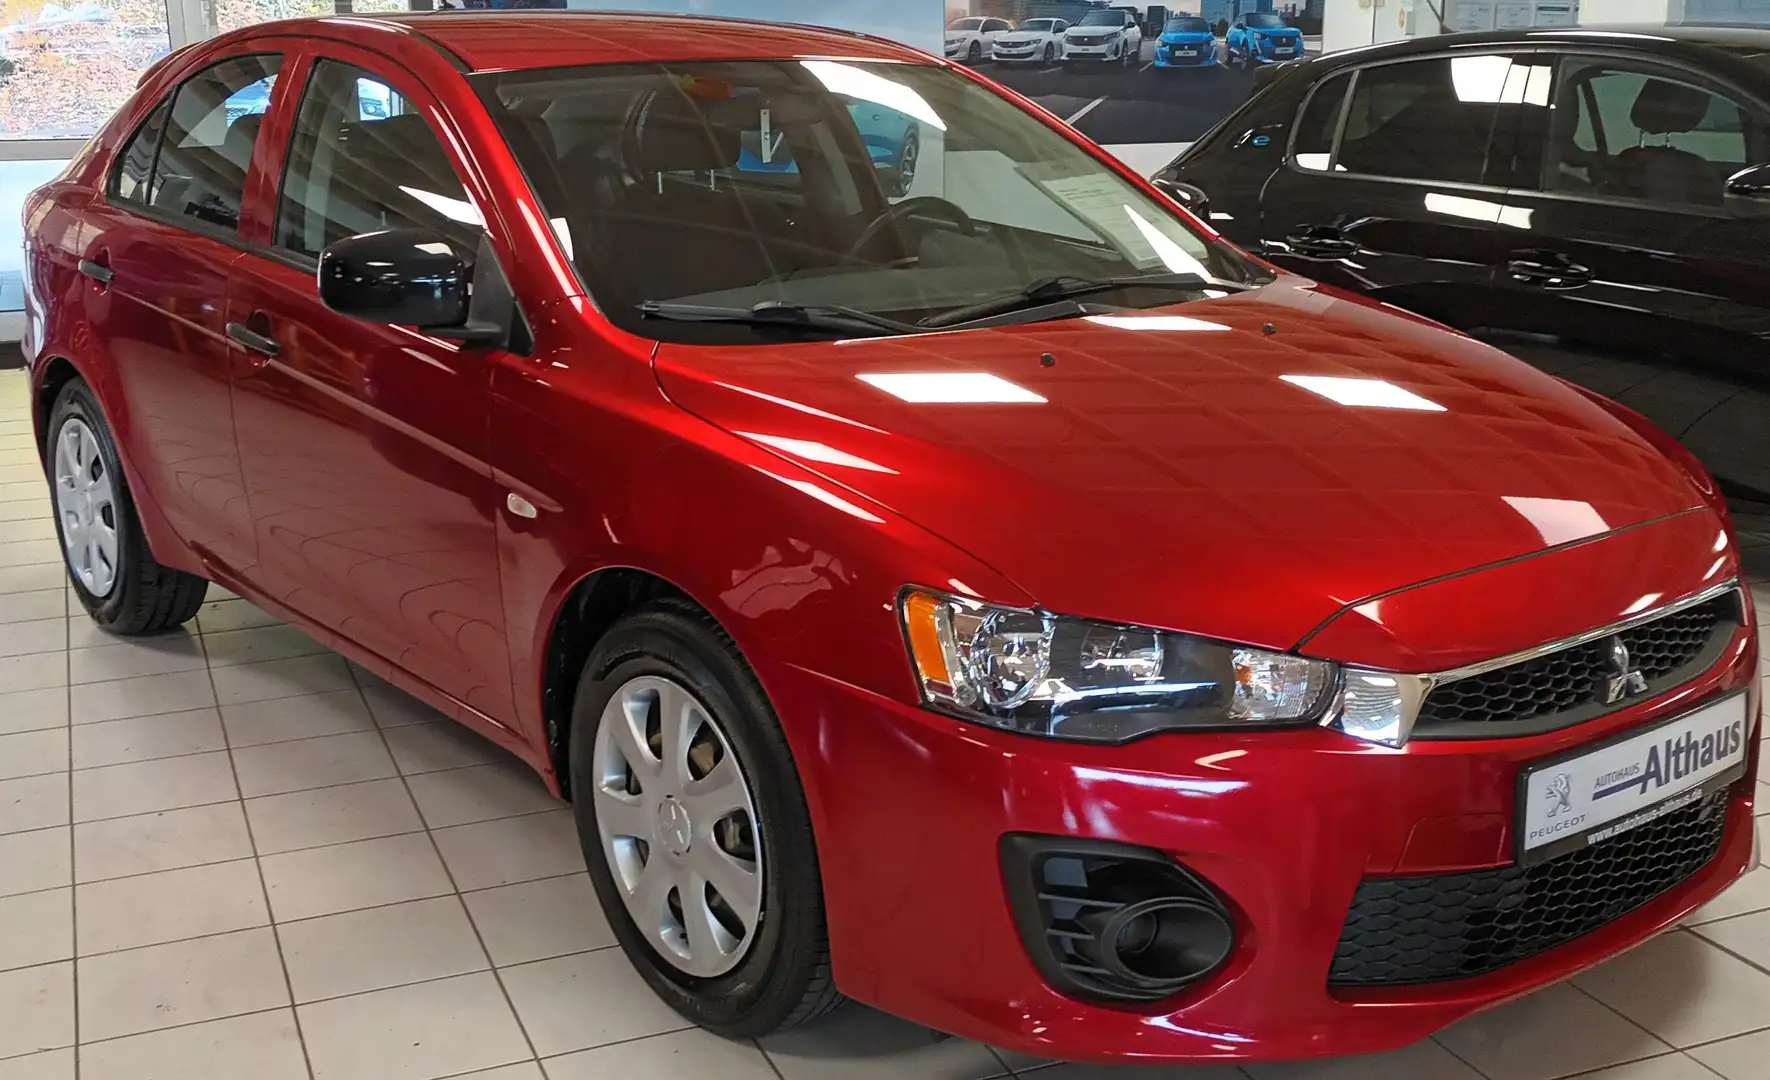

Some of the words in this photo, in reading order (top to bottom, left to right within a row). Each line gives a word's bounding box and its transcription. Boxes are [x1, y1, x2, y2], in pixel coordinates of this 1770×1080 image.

[1594, 762, 1640, 788] AUTOHAUS
[1639, 720, 1741, 795] Althaus
[1530, 814, 1586, 839] PEUGEOT
